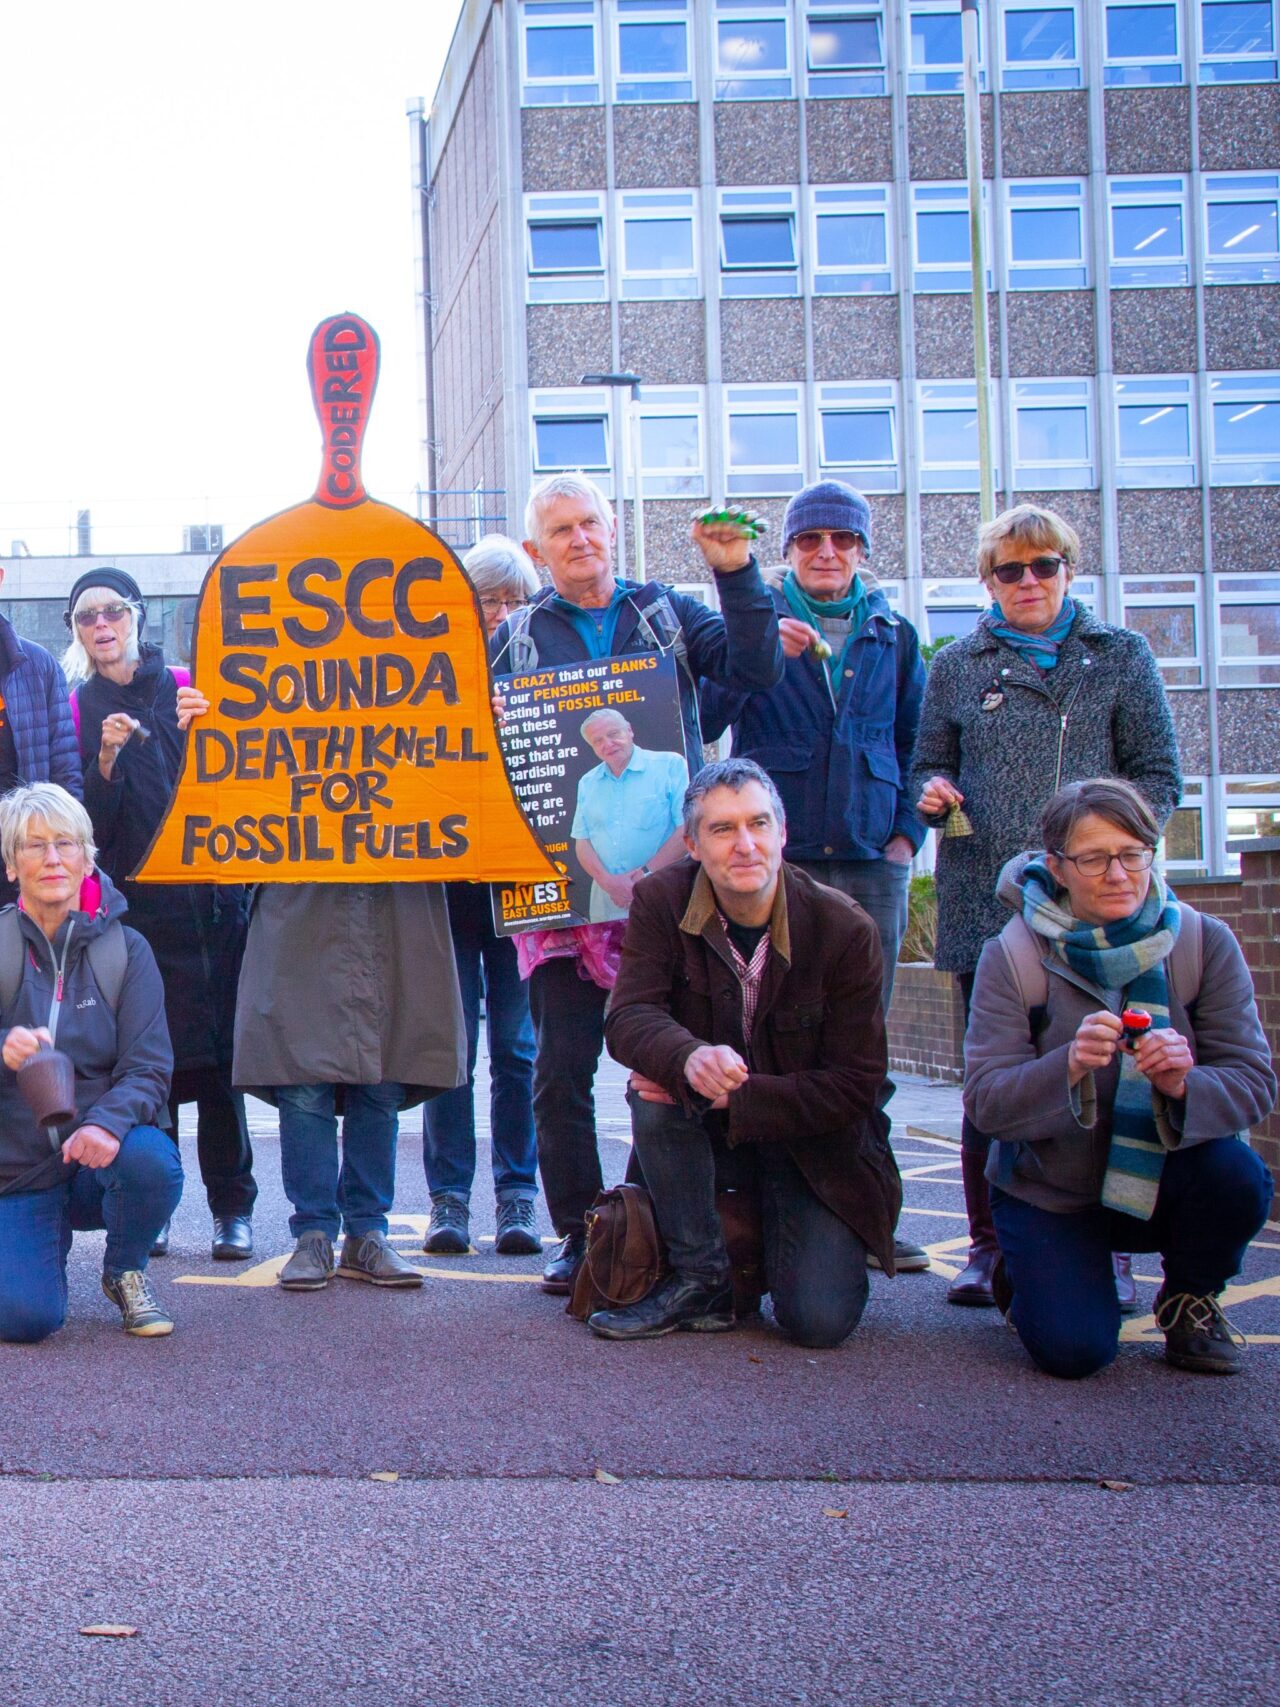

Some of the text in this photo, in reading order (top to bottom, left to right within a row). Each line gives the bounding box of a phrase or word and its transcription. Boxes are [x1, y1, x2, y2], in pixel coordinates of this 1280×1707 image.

[220, 557, 449, 648] ESCC
[513, 673, 555, 690] CRAZY
[558, 670, 584, 683] that
[587, 667, 608, 677] our
[611, 657, 657, 675] BANKS
[510, 693, 531, 704] our
[534, 681, 599, 701] PENSIONS
[602, 679, 623, 691] are
[543, 703, 555, 714] in
[558, 697, 604, 712] FOSSIL
[607, 690, 645, 705] FUEL,
[522, 720, 557, 732] these
[511, 738, 531, 750] the
[534, 733, 562, 747] very
[529, 749, 554, 763] that
[557, 746, 578, 758] are
[291, 770, 393, 813] FOR
[521, 797, 564, 812] we are
[181, 812, 470, 865] FOSSIL FUELS
[502, 882, 568, 908] DIVEST
[503, 900, 570, 919] EAST SUSSEX
